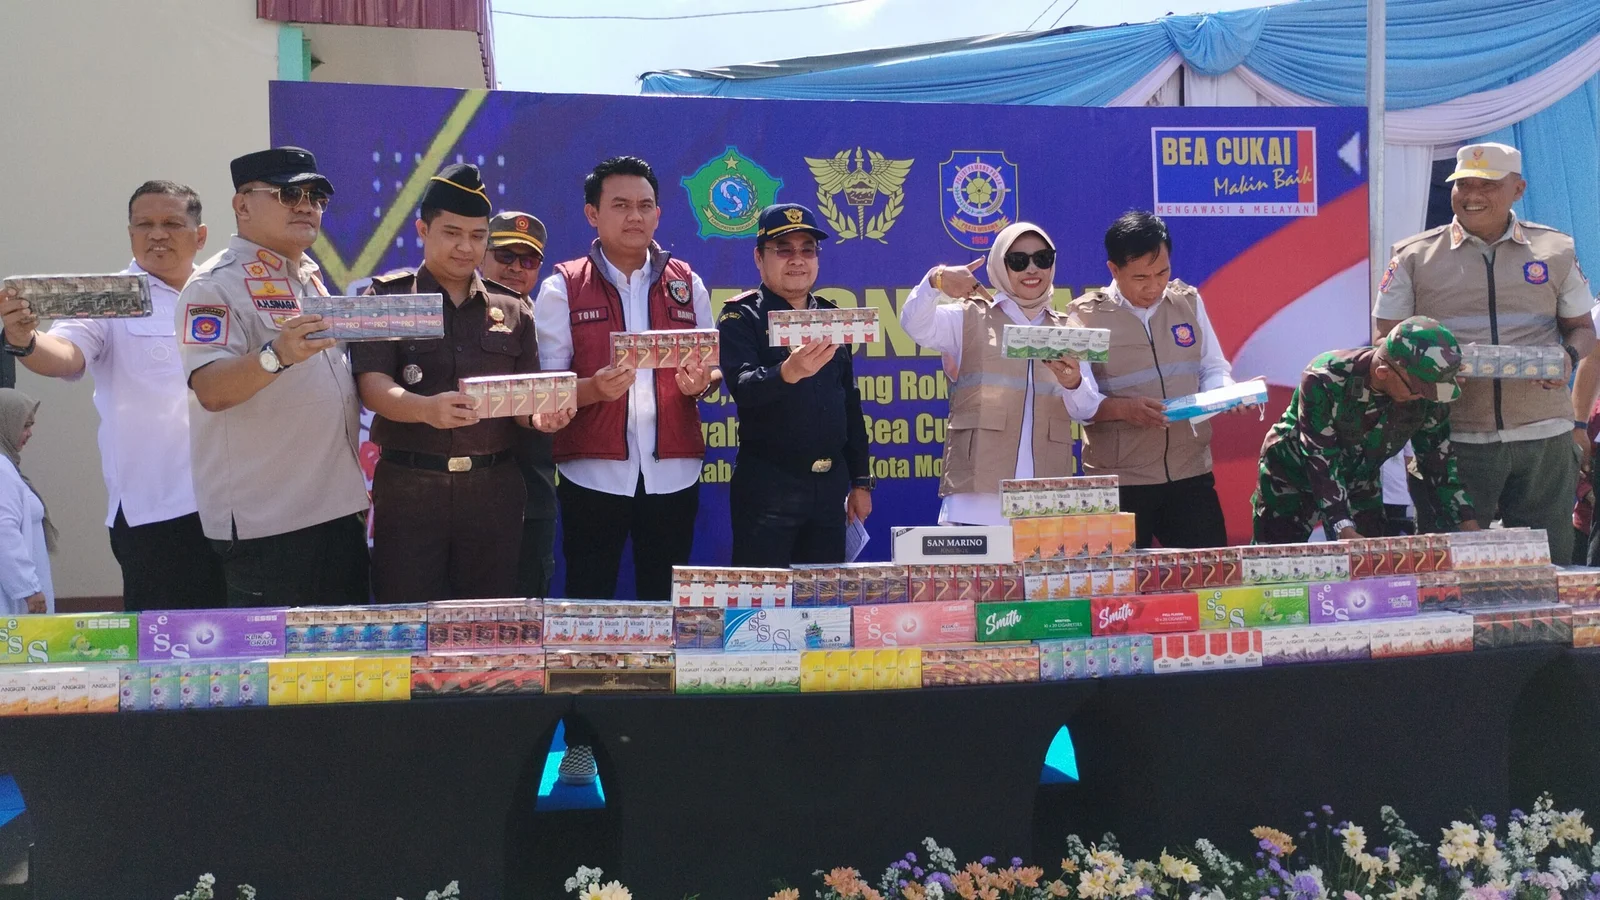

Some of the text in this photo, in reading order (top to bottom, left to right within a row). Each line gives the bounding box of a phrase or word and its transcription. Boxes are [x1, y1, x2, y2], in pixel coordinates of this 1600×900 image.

[1162, 137, 1291, 166] BEA CUKAI
[1213, 166, 1313, 197] Makin Baik
[1157, 204, 1316, 214] MENGAWASI & MELAYANI
[577, 310, 600, 321] TONI
[927, 539, 983, 547] SAN MARINO
[986, 609, 1022, 635] Smith
[1099, 603, 1134, 629] Smith
